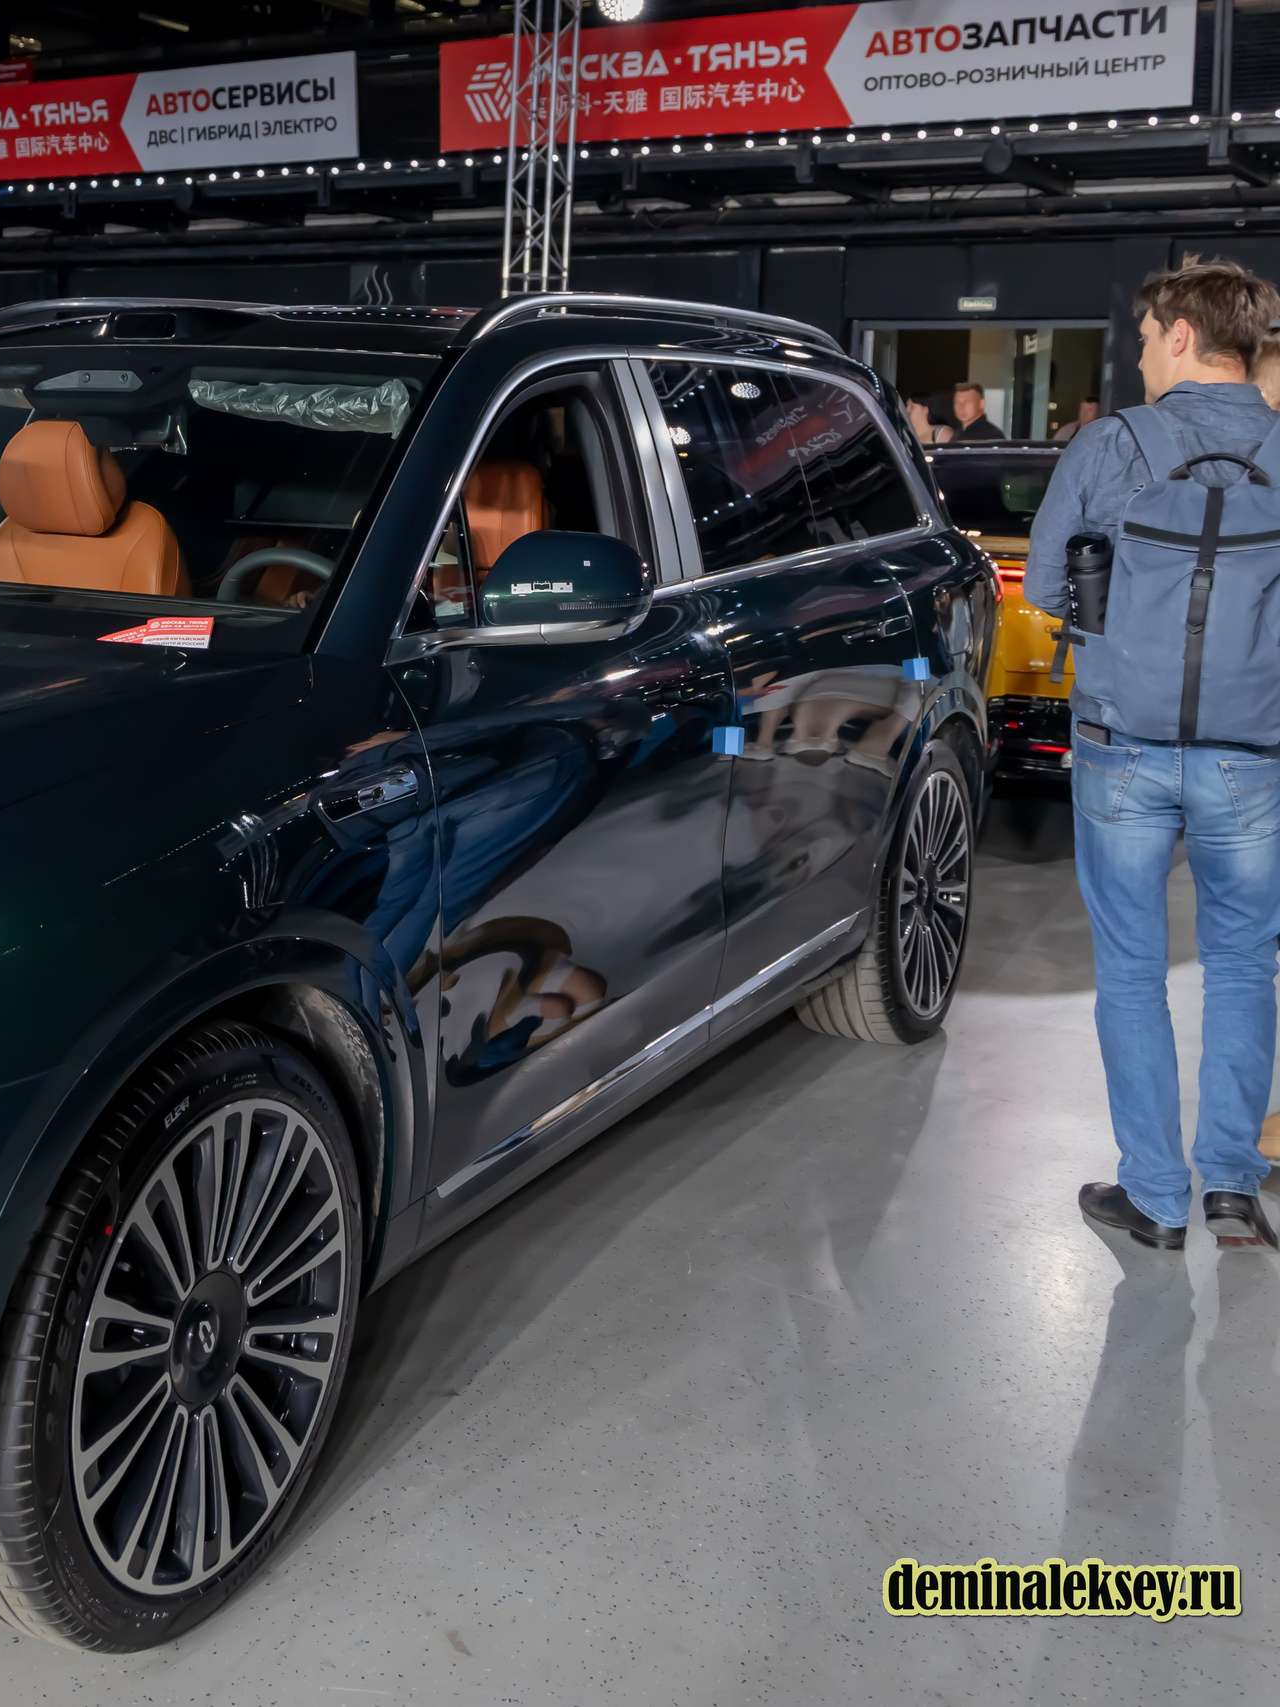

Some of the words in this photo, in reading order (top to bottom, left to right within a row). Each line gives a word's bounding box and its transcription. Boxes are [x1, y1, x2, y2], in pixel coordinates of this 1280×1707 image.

[865, 5, 1167, 58] АВТОЗАПЧАСТИ
[864, 58, 1089, 91] ОПТОВО-РОЗНИЧНЫЙ
[1095, 54, 1166, 76] ЦЕНТР
[146, 76, 336, 117] АВТОСЕРВИСЫ
[659, 77, 805, 112] 国际汽车中心
